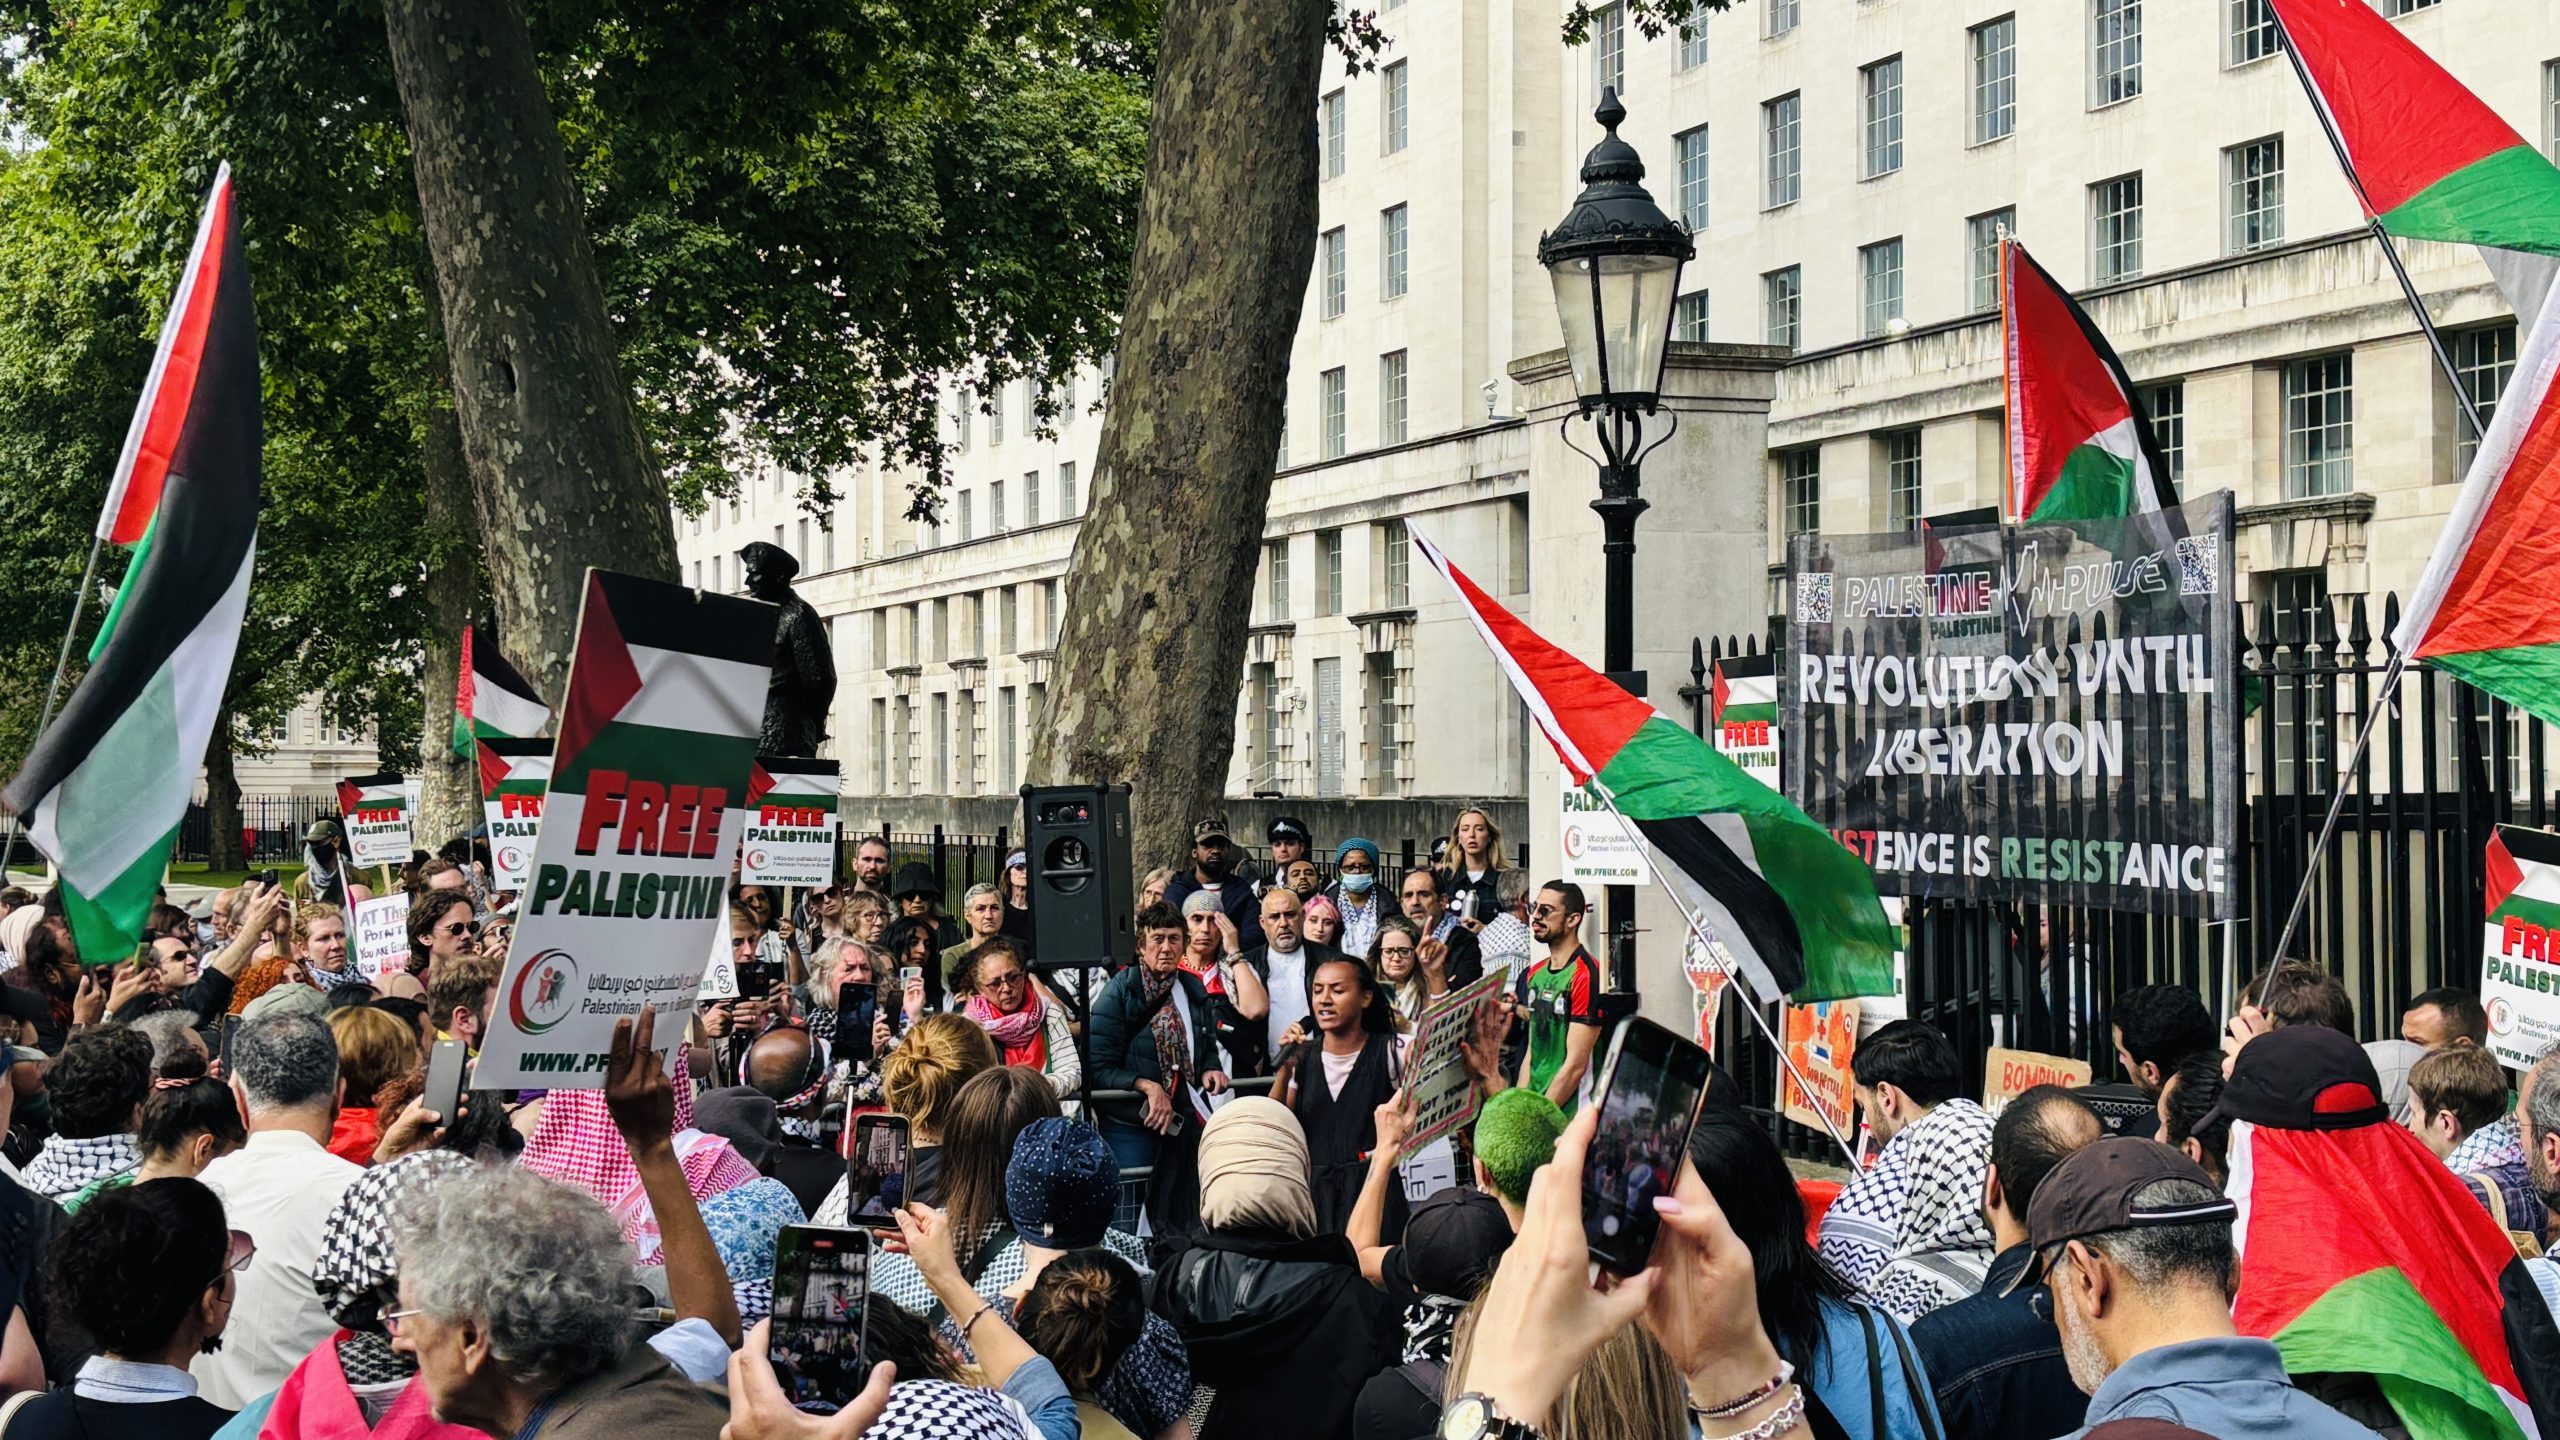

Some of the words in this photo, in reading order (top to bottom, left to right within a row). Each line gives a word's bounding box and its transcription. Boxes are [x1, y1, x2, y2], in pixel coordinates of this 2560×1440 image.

[1844, 571, 1991, 617] PALESTINE
[2062, 550, 2167, 610] PULSE
[1800, 647, 2058, 709] REVOLUTION
[2069, 634, 2214, 695] UNTIL
[1724, 720, 1769, 749] FREE
[1727, 751, 1777, 768] ESTINE
[1865, 720, 2123, 777] LIBERATION
[357, 807, 400, 824] FREE
[500, 793, 544, 819] FR
[575, 769, 727, 859] FREE
[760, 805, 826, 827] FREE
[352, 823, 407, 836] PALESTINE
[748, 828, 832, 844] PALESTINE
[1826, 829, 1955, 874] STENCE
[1963, 835, 1990, 877] IS
[2002, 837, 2225, 893] RESISTANCE
[360, 909, 379, 927] AT
[364, 925, 404, 942] POINT
[2502, 915, 2560, 966] FRE
[2487, 956, 2560, 995] PALEST
[581, 998, 640, 1015] Palestinian
